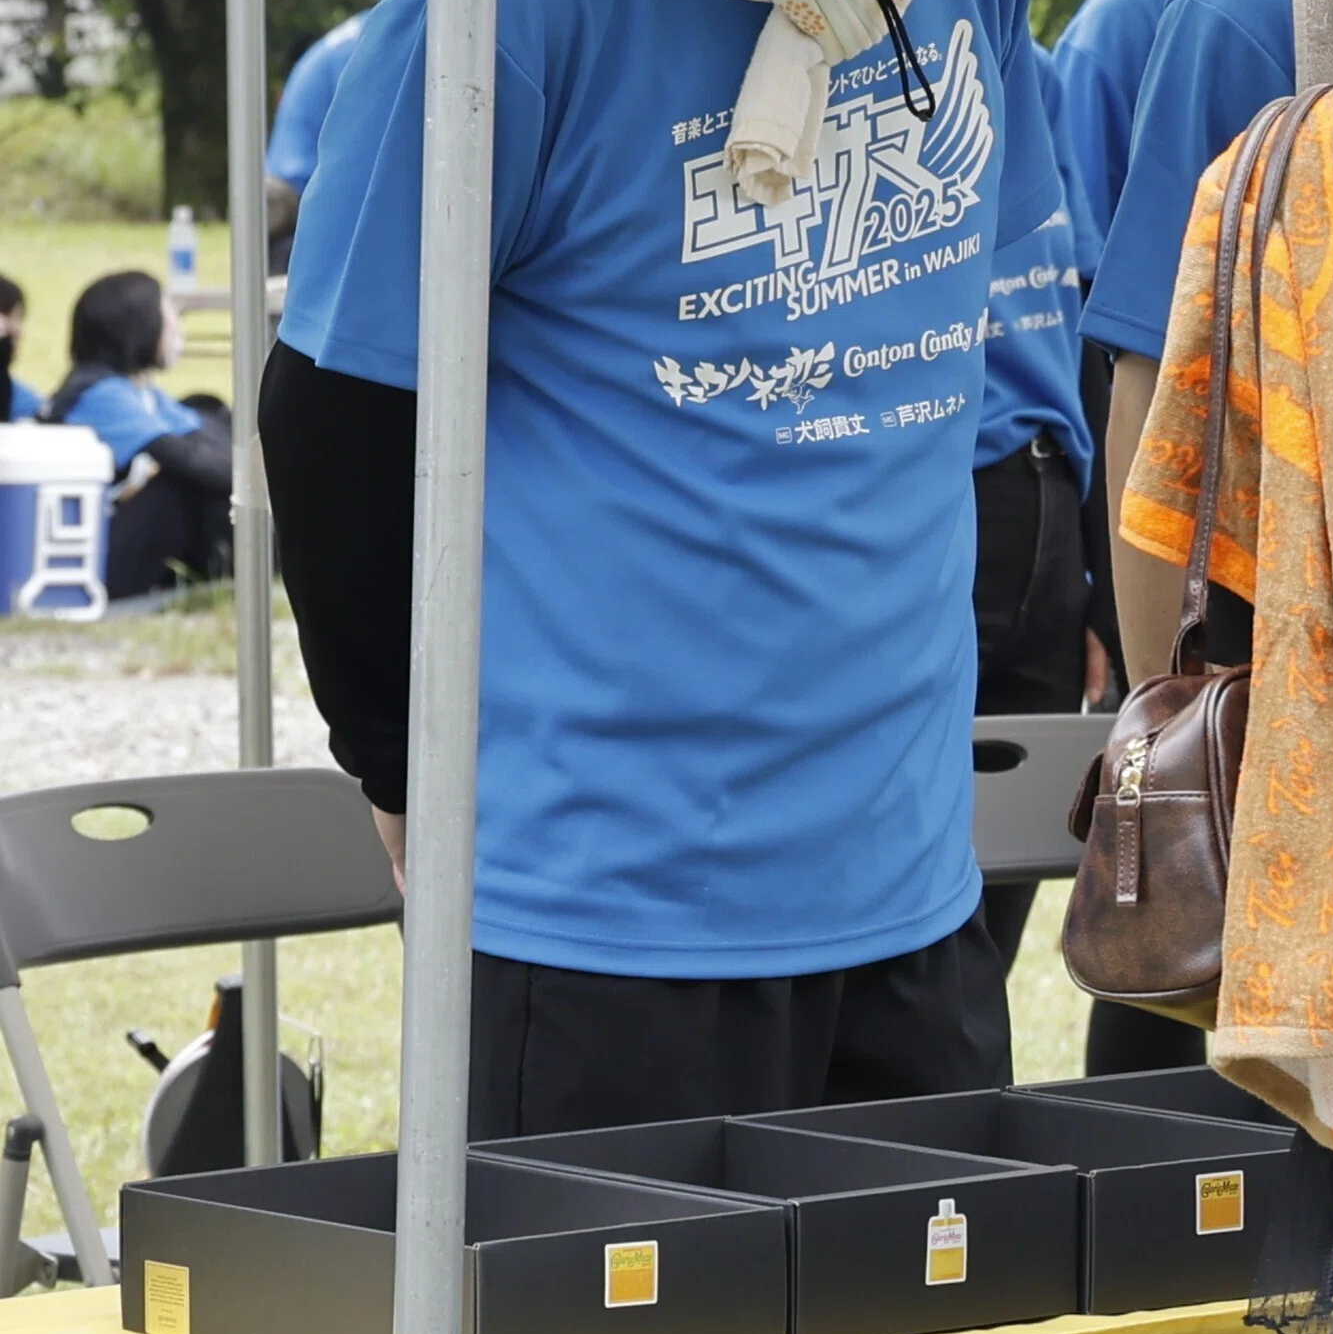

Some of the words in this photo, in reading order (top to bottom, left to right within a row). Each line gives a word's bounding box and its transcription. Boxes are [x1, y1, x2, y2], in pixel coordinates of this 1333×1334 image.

[862, 175, 965, 255] 2025
[678, 260, 818, 321] EXCITING
[785, 258, 901, 322] SUMMER
[903, 260, 922, 283] in
[922, 233, 981, 275] WAJIKI
[843, 343, 916, 378] Conton
[919, 321, 974, 362] Candy
[794, 413, 870, 445] 犬飼貴丈
[895, 392, 967, 428] 芦沢ムネト
